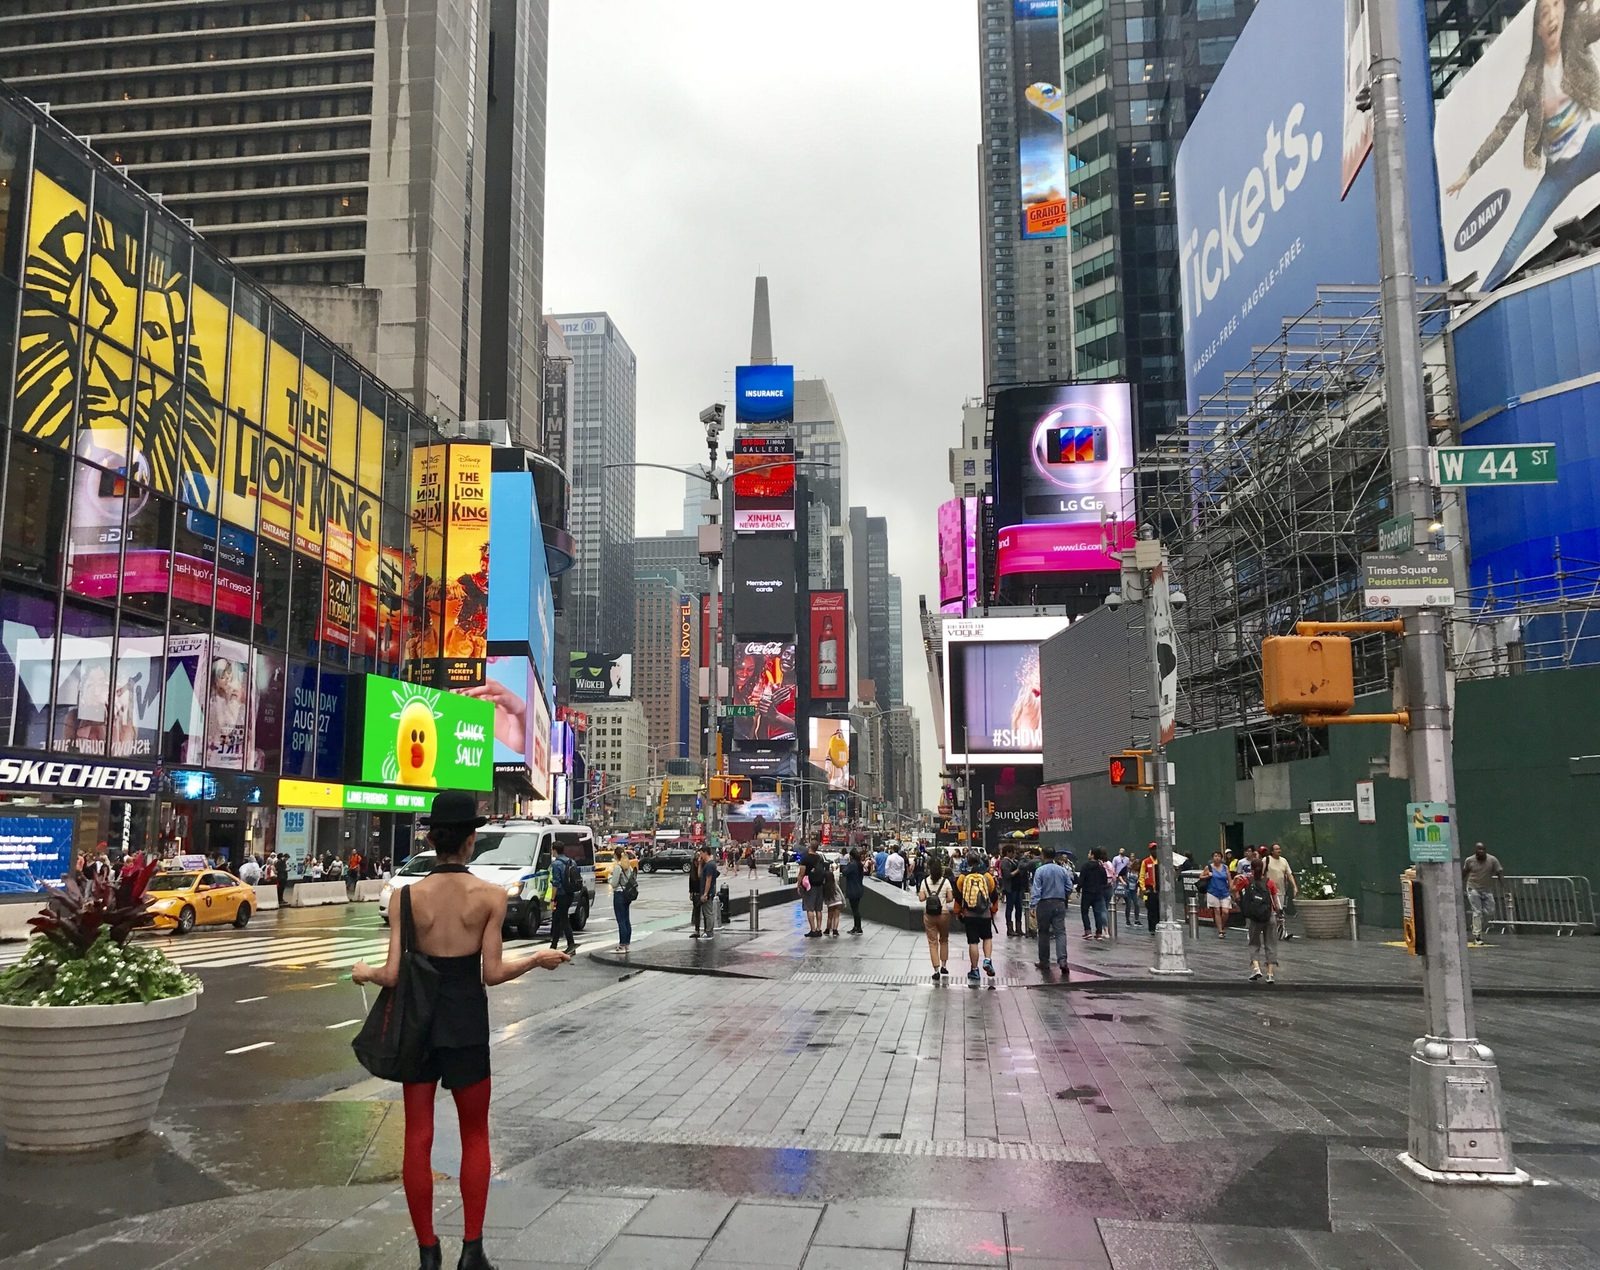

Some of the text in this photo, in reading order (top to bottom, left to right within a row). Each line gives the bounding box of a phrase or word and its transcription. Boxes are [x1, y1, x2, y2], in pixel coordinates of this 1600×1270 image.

[1030, 205, 1060, 221] GRAND
[1459, 195, 1504, 247] OLD NAVY
[1192, 236, 1305, 377] HASSLE-FREE. HAGGLE-FREE.
[745, 390, 784, 398] INSURANCE
[286, 388, 327, 446] THE
[547, 383, 563, 465] TIMES
[234, 407, 372, 542] LION KING
[1441, 450, 1549, 481] W 44 ST
[459, 472, 479, 482] THE
[455, 484, 484, 501] LION
[1060, 496, 1104, 511] LG G6
[451, 501, 488, 522] KING
[747, 514, 782, 522] XINHUA
[262, 521, 291, 541] ENTRANCE
[297, 537, 306, 546] ON
[761, 522, 790, 530] AGENCY
[1379, 524, 1412, 551] Broadway
[1367, 565, 1438, 576] Times Square
[1368, 576, 1449, 586] Pedestrian Plaza
[681, 600, 691, 658] NOVOTEL
[294, 687, 338, 713] SUNDAY
[727, 706, 735, 716] W
[737, 706, 747, 716] 44
[293, 709, 330, 734] AUG 27
[291, 731, 313, 753] 8PM
[455, 744, 484, 767] SALLY
[0, 758, 153, 792] SKECHERS
[283, 811, 304, 827] 1515
